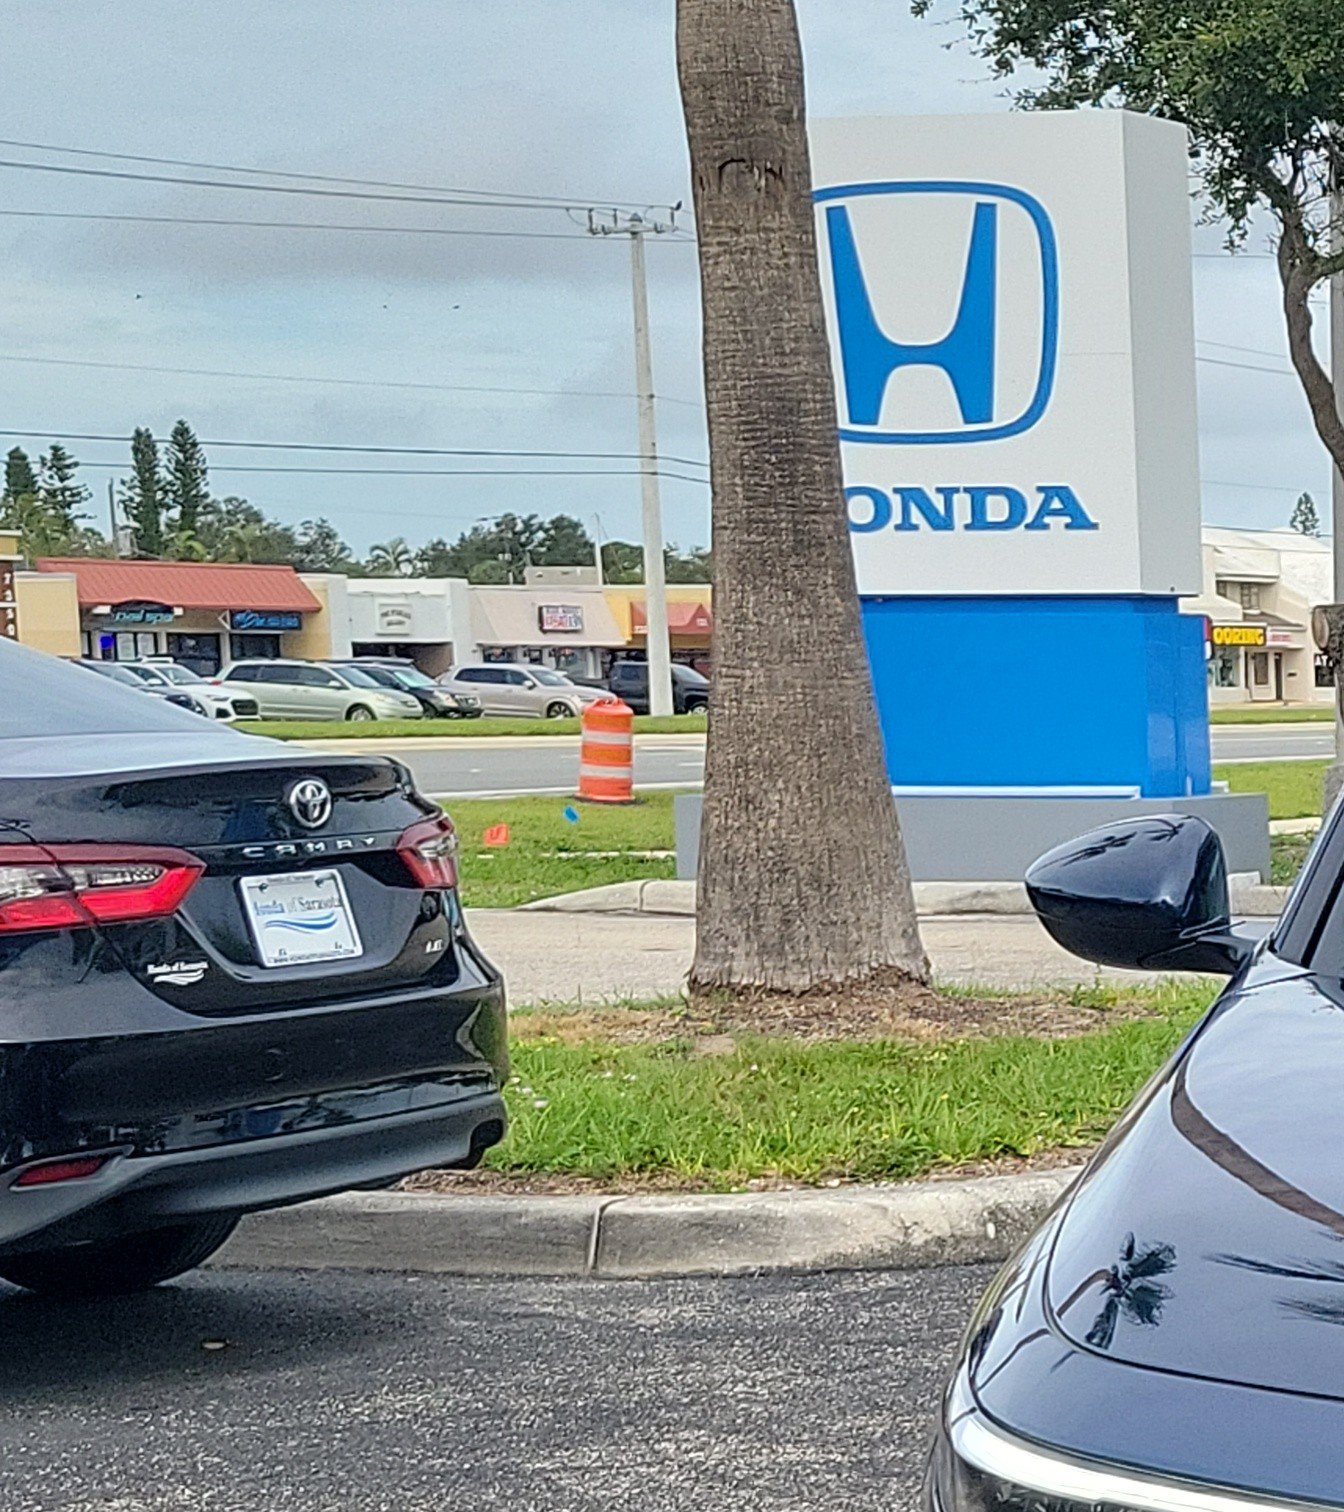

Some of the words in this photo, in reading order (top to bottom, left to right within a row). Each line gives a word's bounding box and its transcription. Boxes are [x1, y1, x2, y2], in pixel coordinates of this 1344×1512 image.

[825, 201, 997, 426] H
[842, 485, 1100, 532] ONDA
[1212, 627, 1264, 646] OORING
[242, 837, 375, 858] CAMRY
